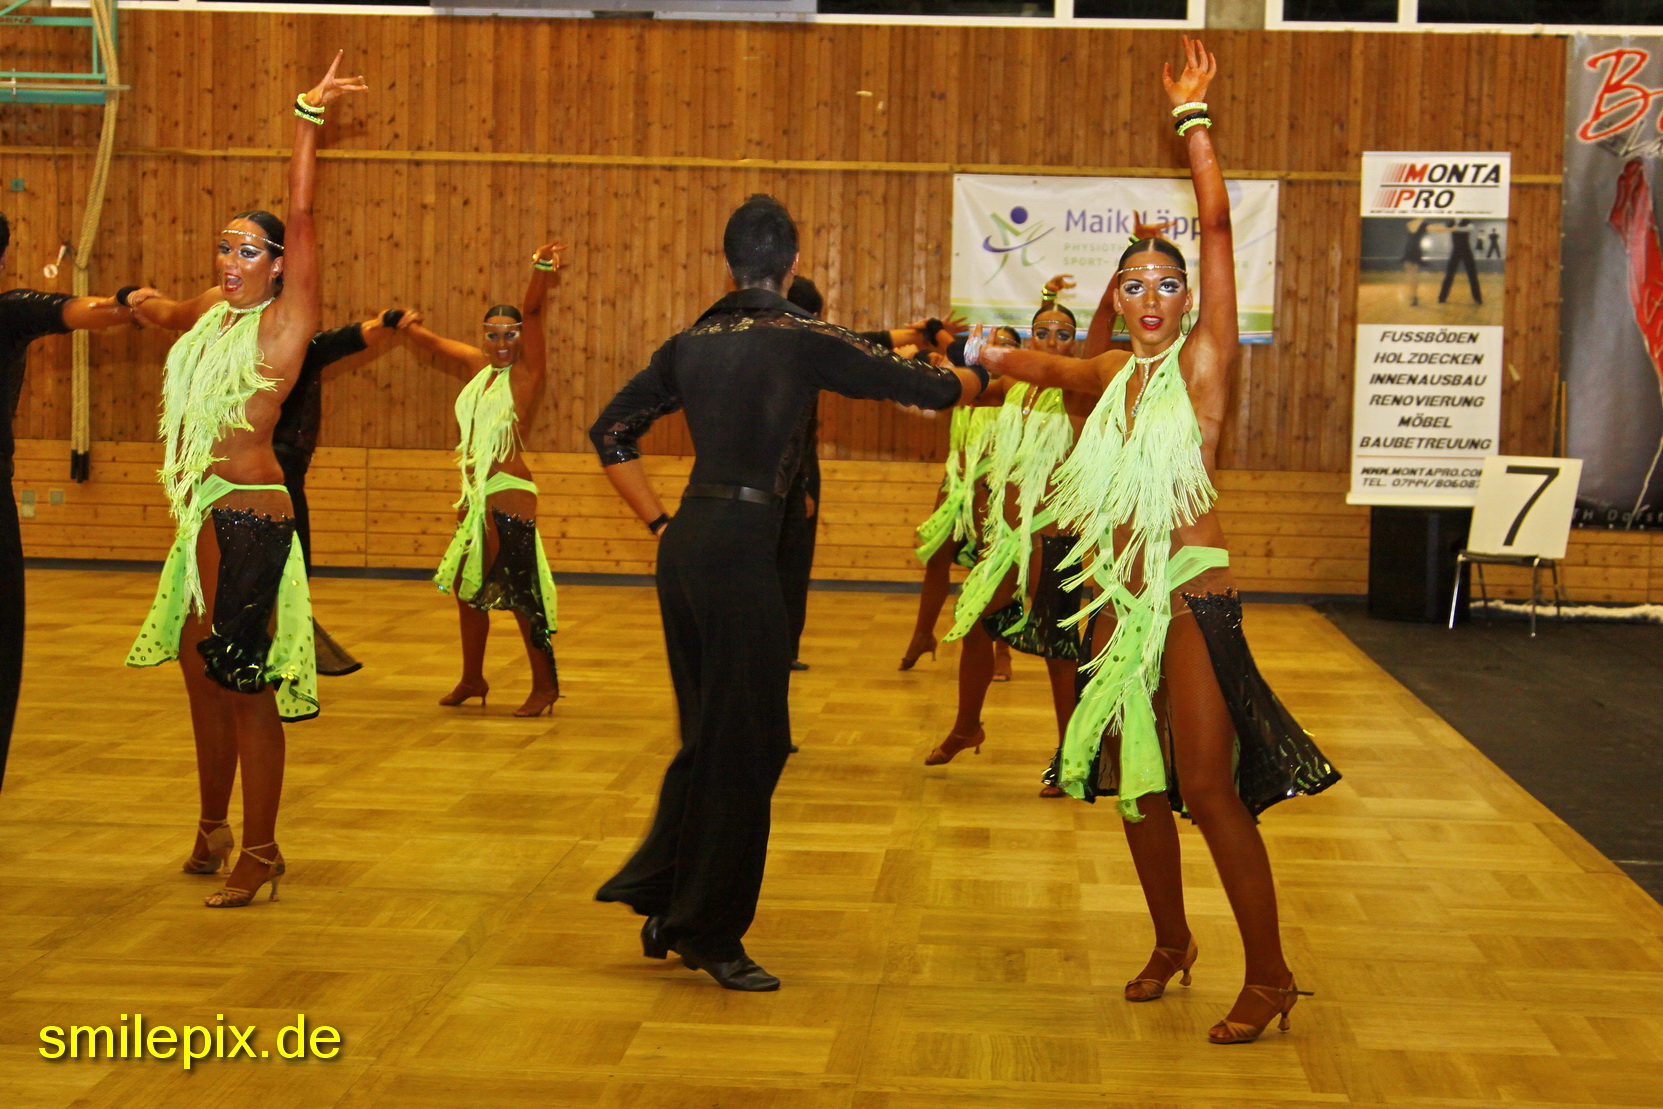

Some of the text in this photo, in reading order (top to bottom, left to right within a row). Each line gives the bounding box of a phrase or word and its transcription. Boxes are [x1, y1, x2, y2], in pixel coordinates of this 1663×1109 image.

[1403, 163, 1502, 183] MONTA
[1394, 189, 1456, 209] PRO
[1065, 208, 1130, 234] Maik
[1380, 328, 1480, 344] FUSSBÖDEN
[1373, 352, 1485, 365] HOLZDECKEN
[1369, 373, 1488, 386] INNENAUSBAU
[1369, 394, 1486, 407] RENOVIERUNG
[1397, 413, 1453, 428] MÖBEL
[1359, 436, 1493, 450] BAUBETREUUNG
[1361, 477, 1388, 488] TEL.
[1502, 464, 1561, 547] 7
